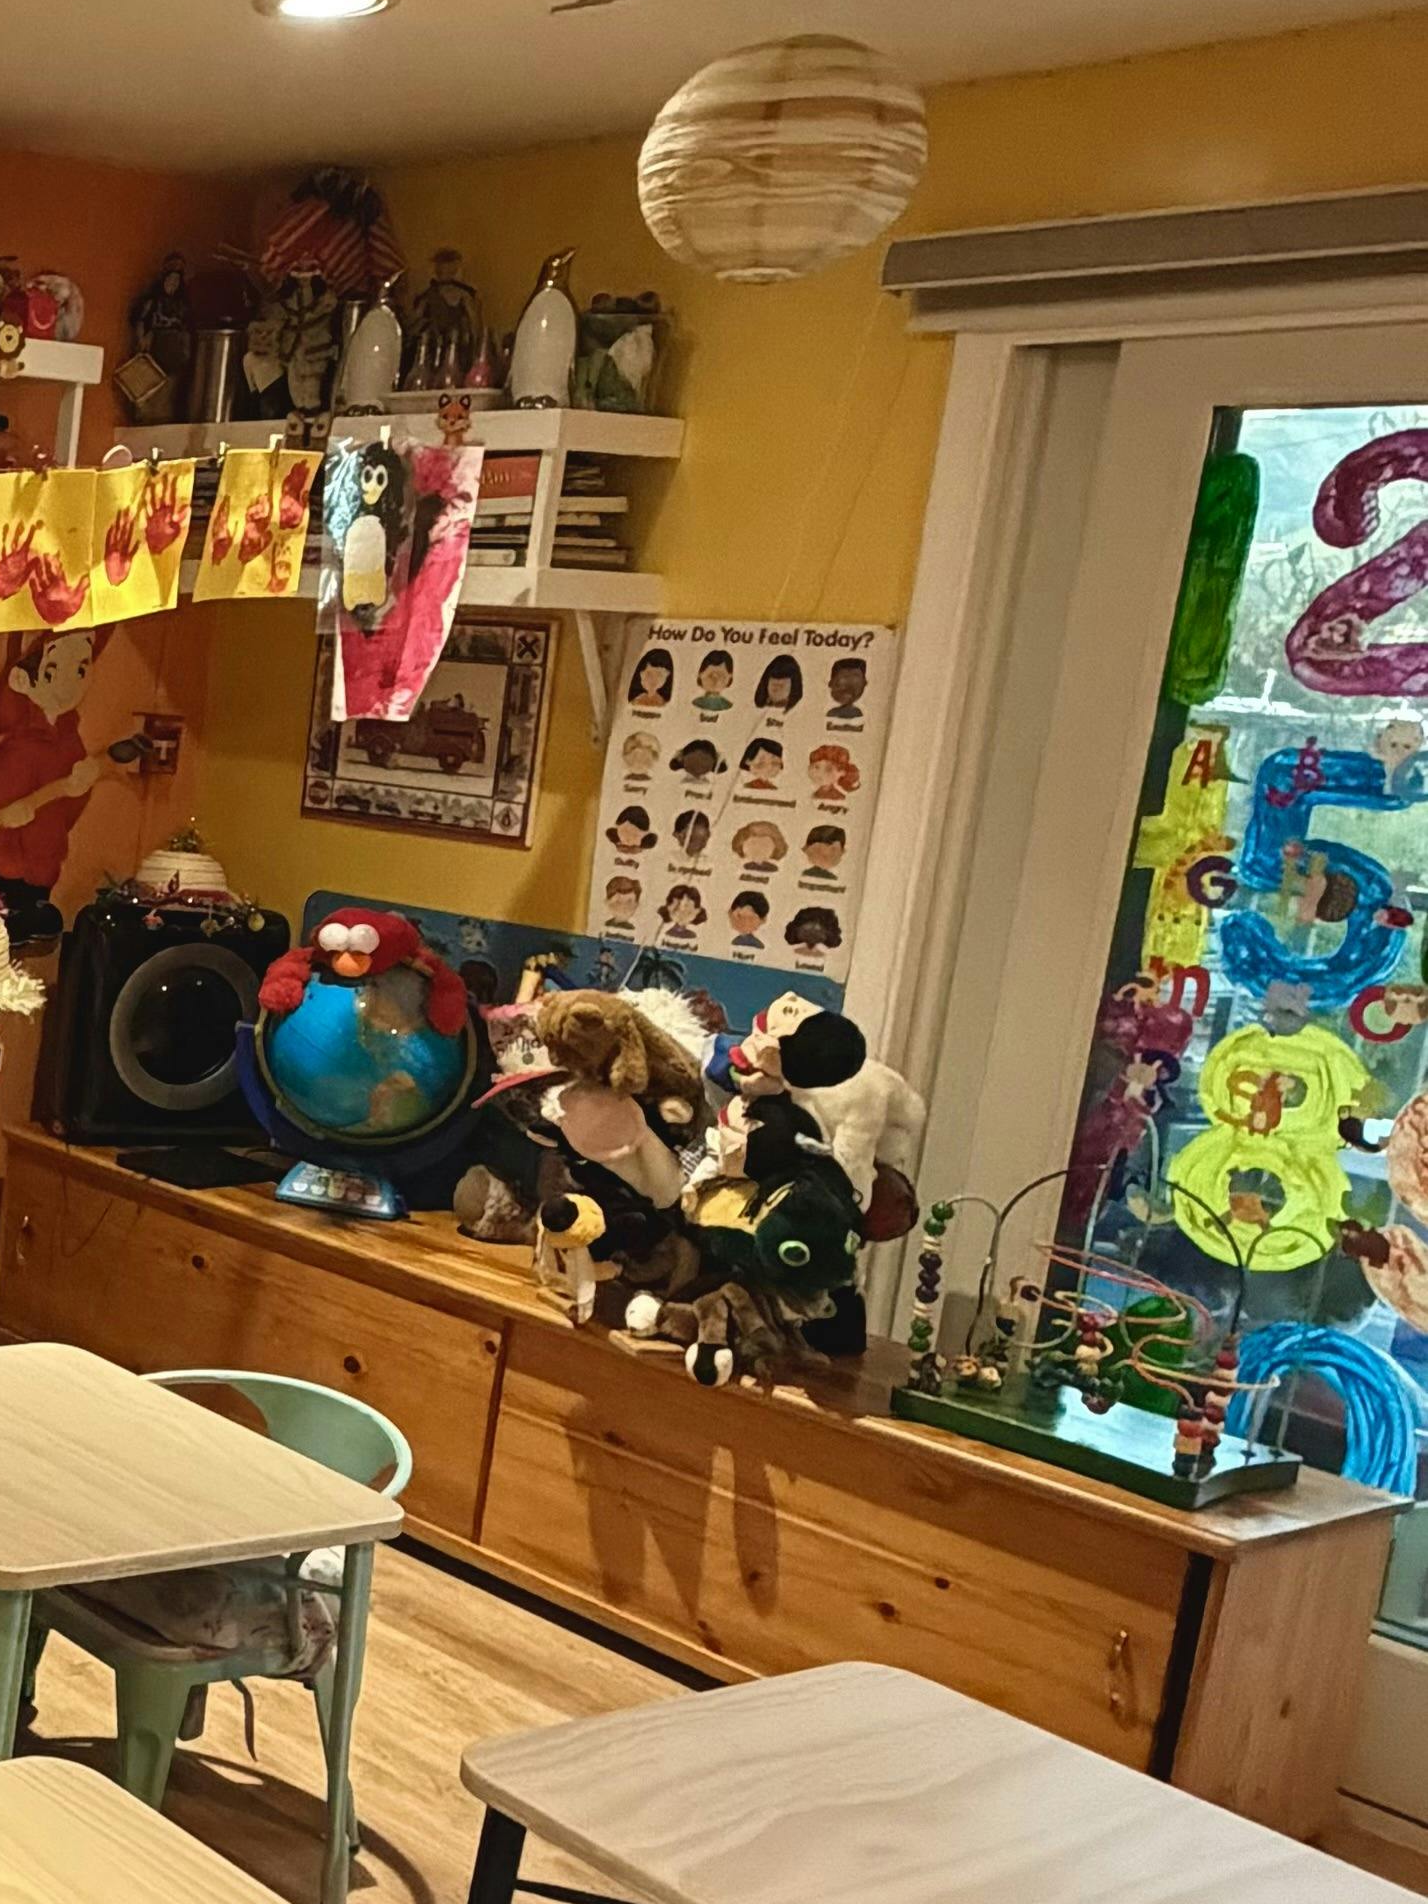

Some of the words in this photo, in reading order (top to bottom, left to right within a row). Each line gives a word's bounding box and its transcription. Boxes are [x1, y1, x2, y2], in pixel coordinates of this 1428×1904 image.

[648, 625, 687, 642] How
[691, 625, 716, 643] Do
[721, 626, 754, 644] You
[758, 628, 799, 646] Feel
[803, 629, 875, 651] Today?
[1186, 855, 1238, 909] G
[1168, 1024, 1369, 1273] 8
